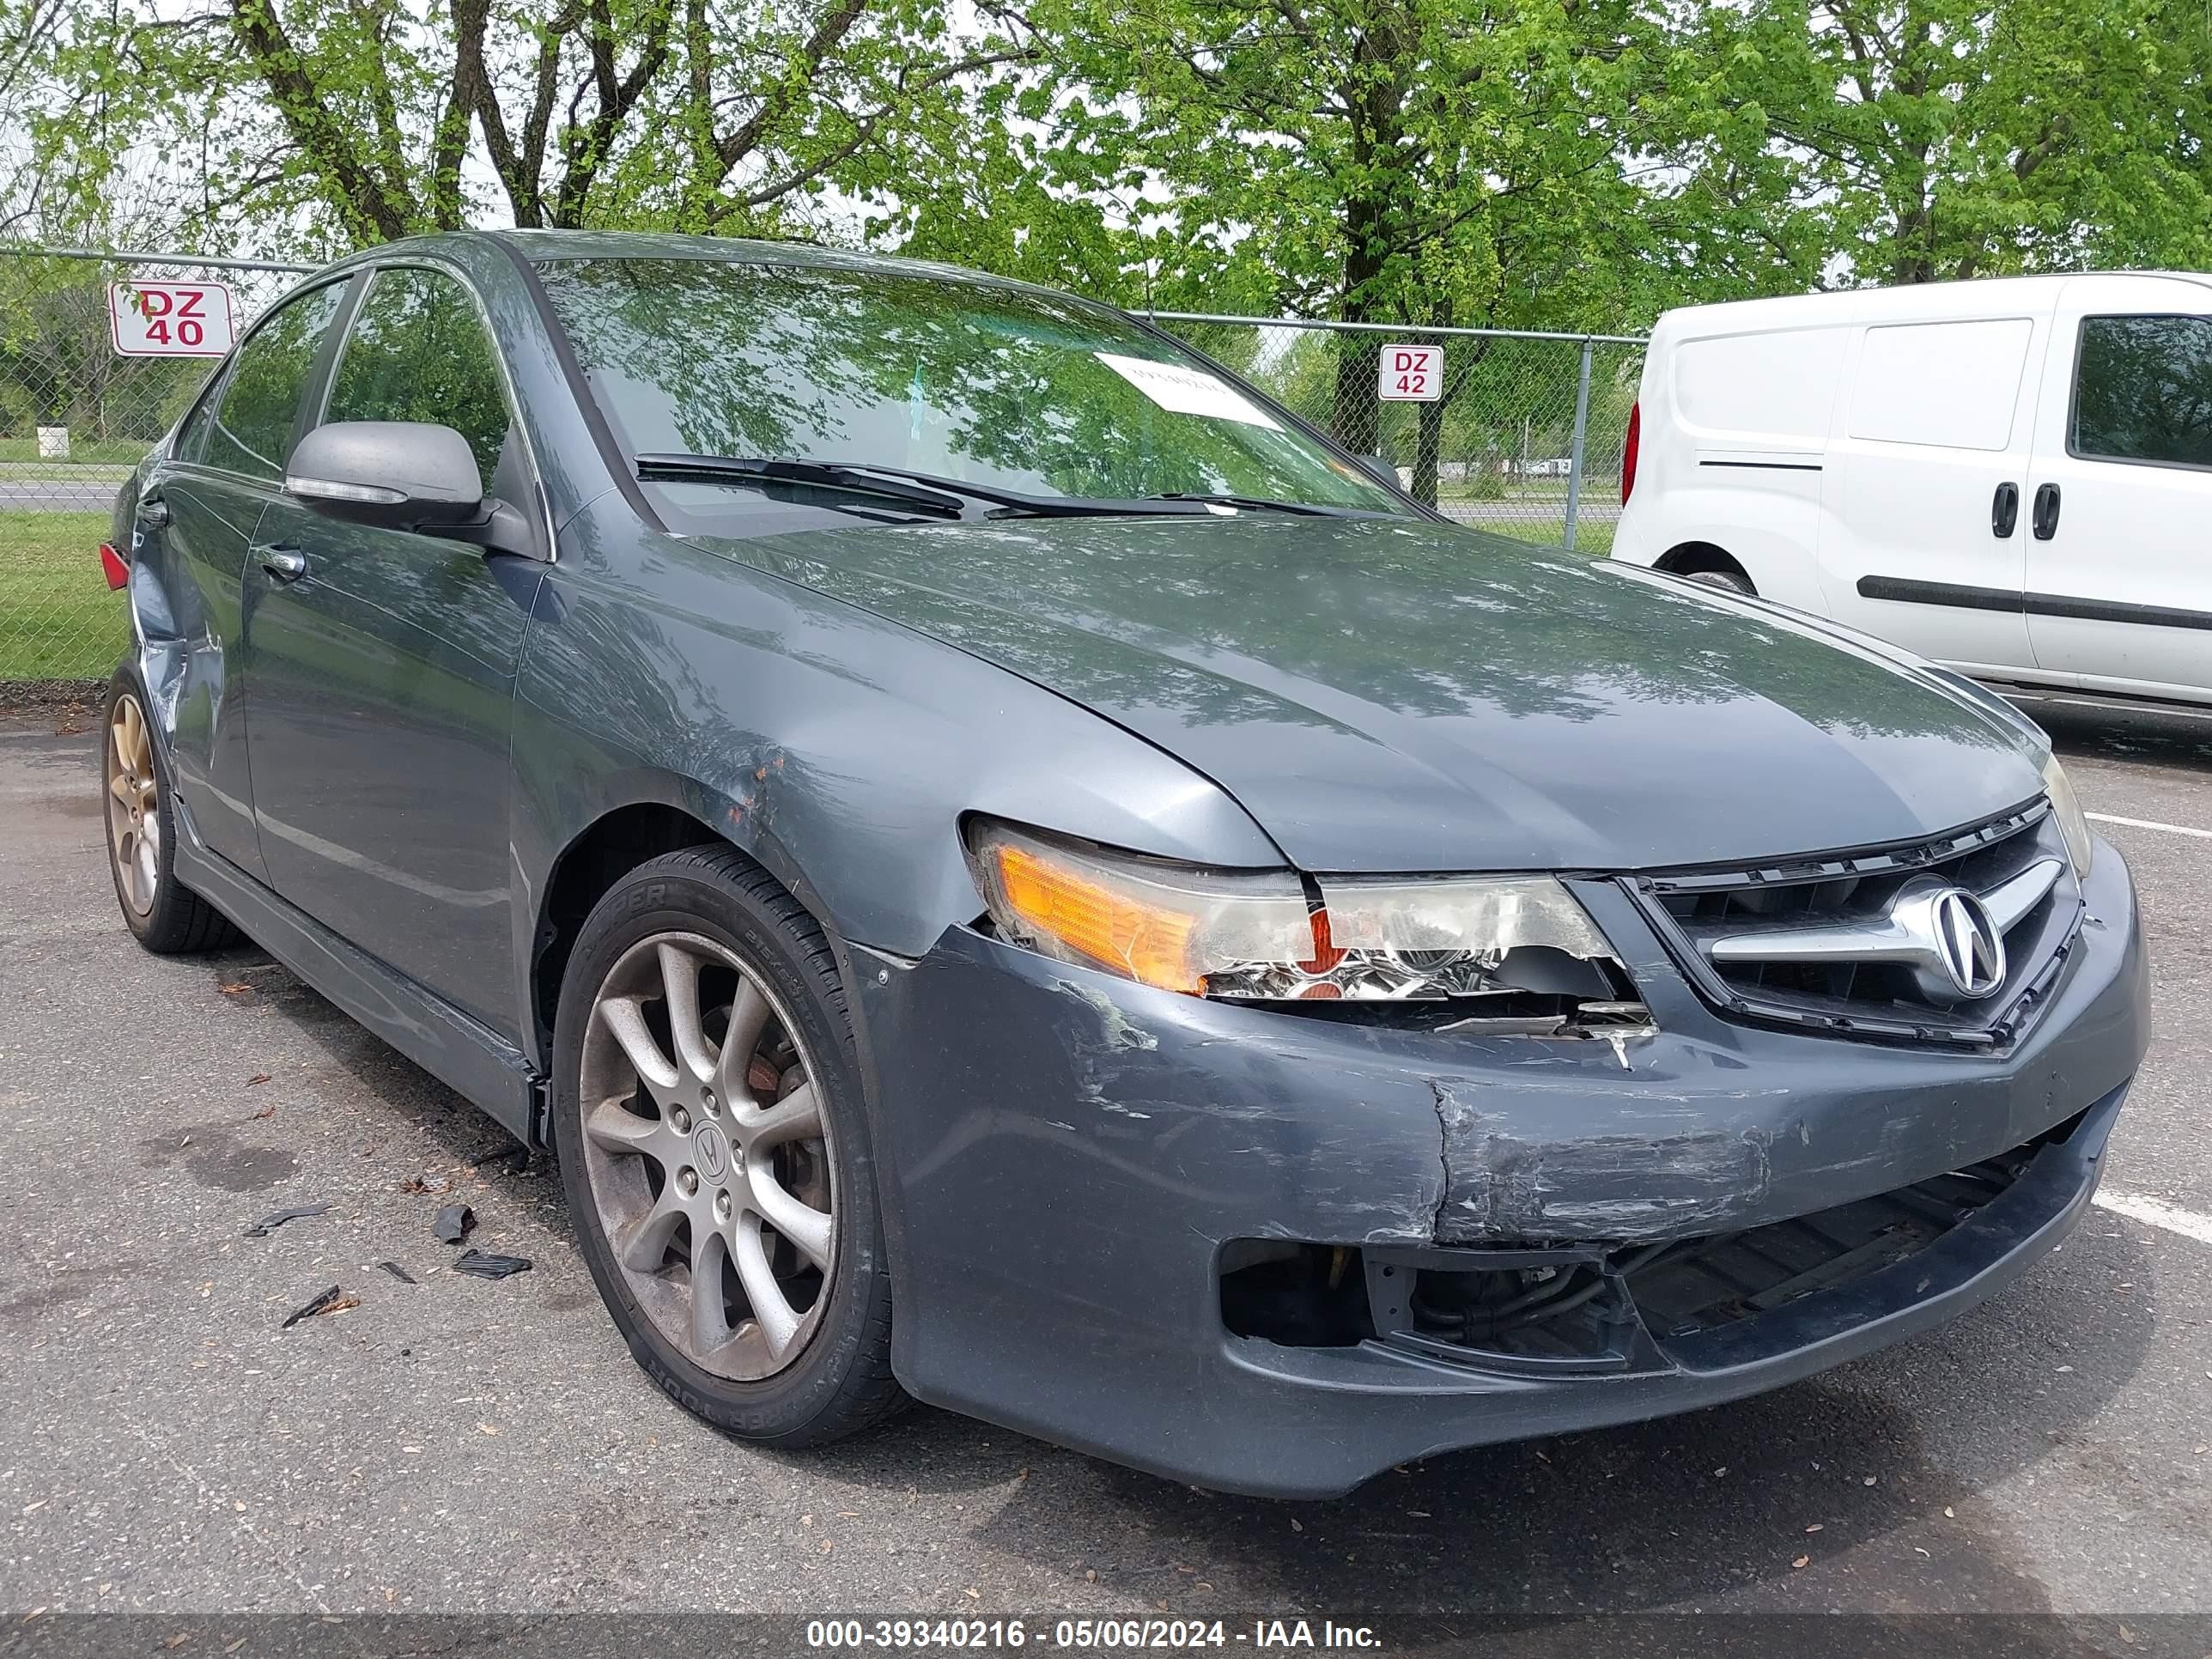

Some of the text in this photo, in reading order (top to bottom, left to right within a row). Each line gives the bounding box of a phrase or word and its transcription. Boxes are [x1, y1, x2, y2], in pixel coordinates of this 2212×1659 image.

[139, 290, 206, 318] DZ
[145, 319, 204, 346] 40
[1395, 352, 1429, 372] DZ
[1395, 374, 1425, 393] 42
